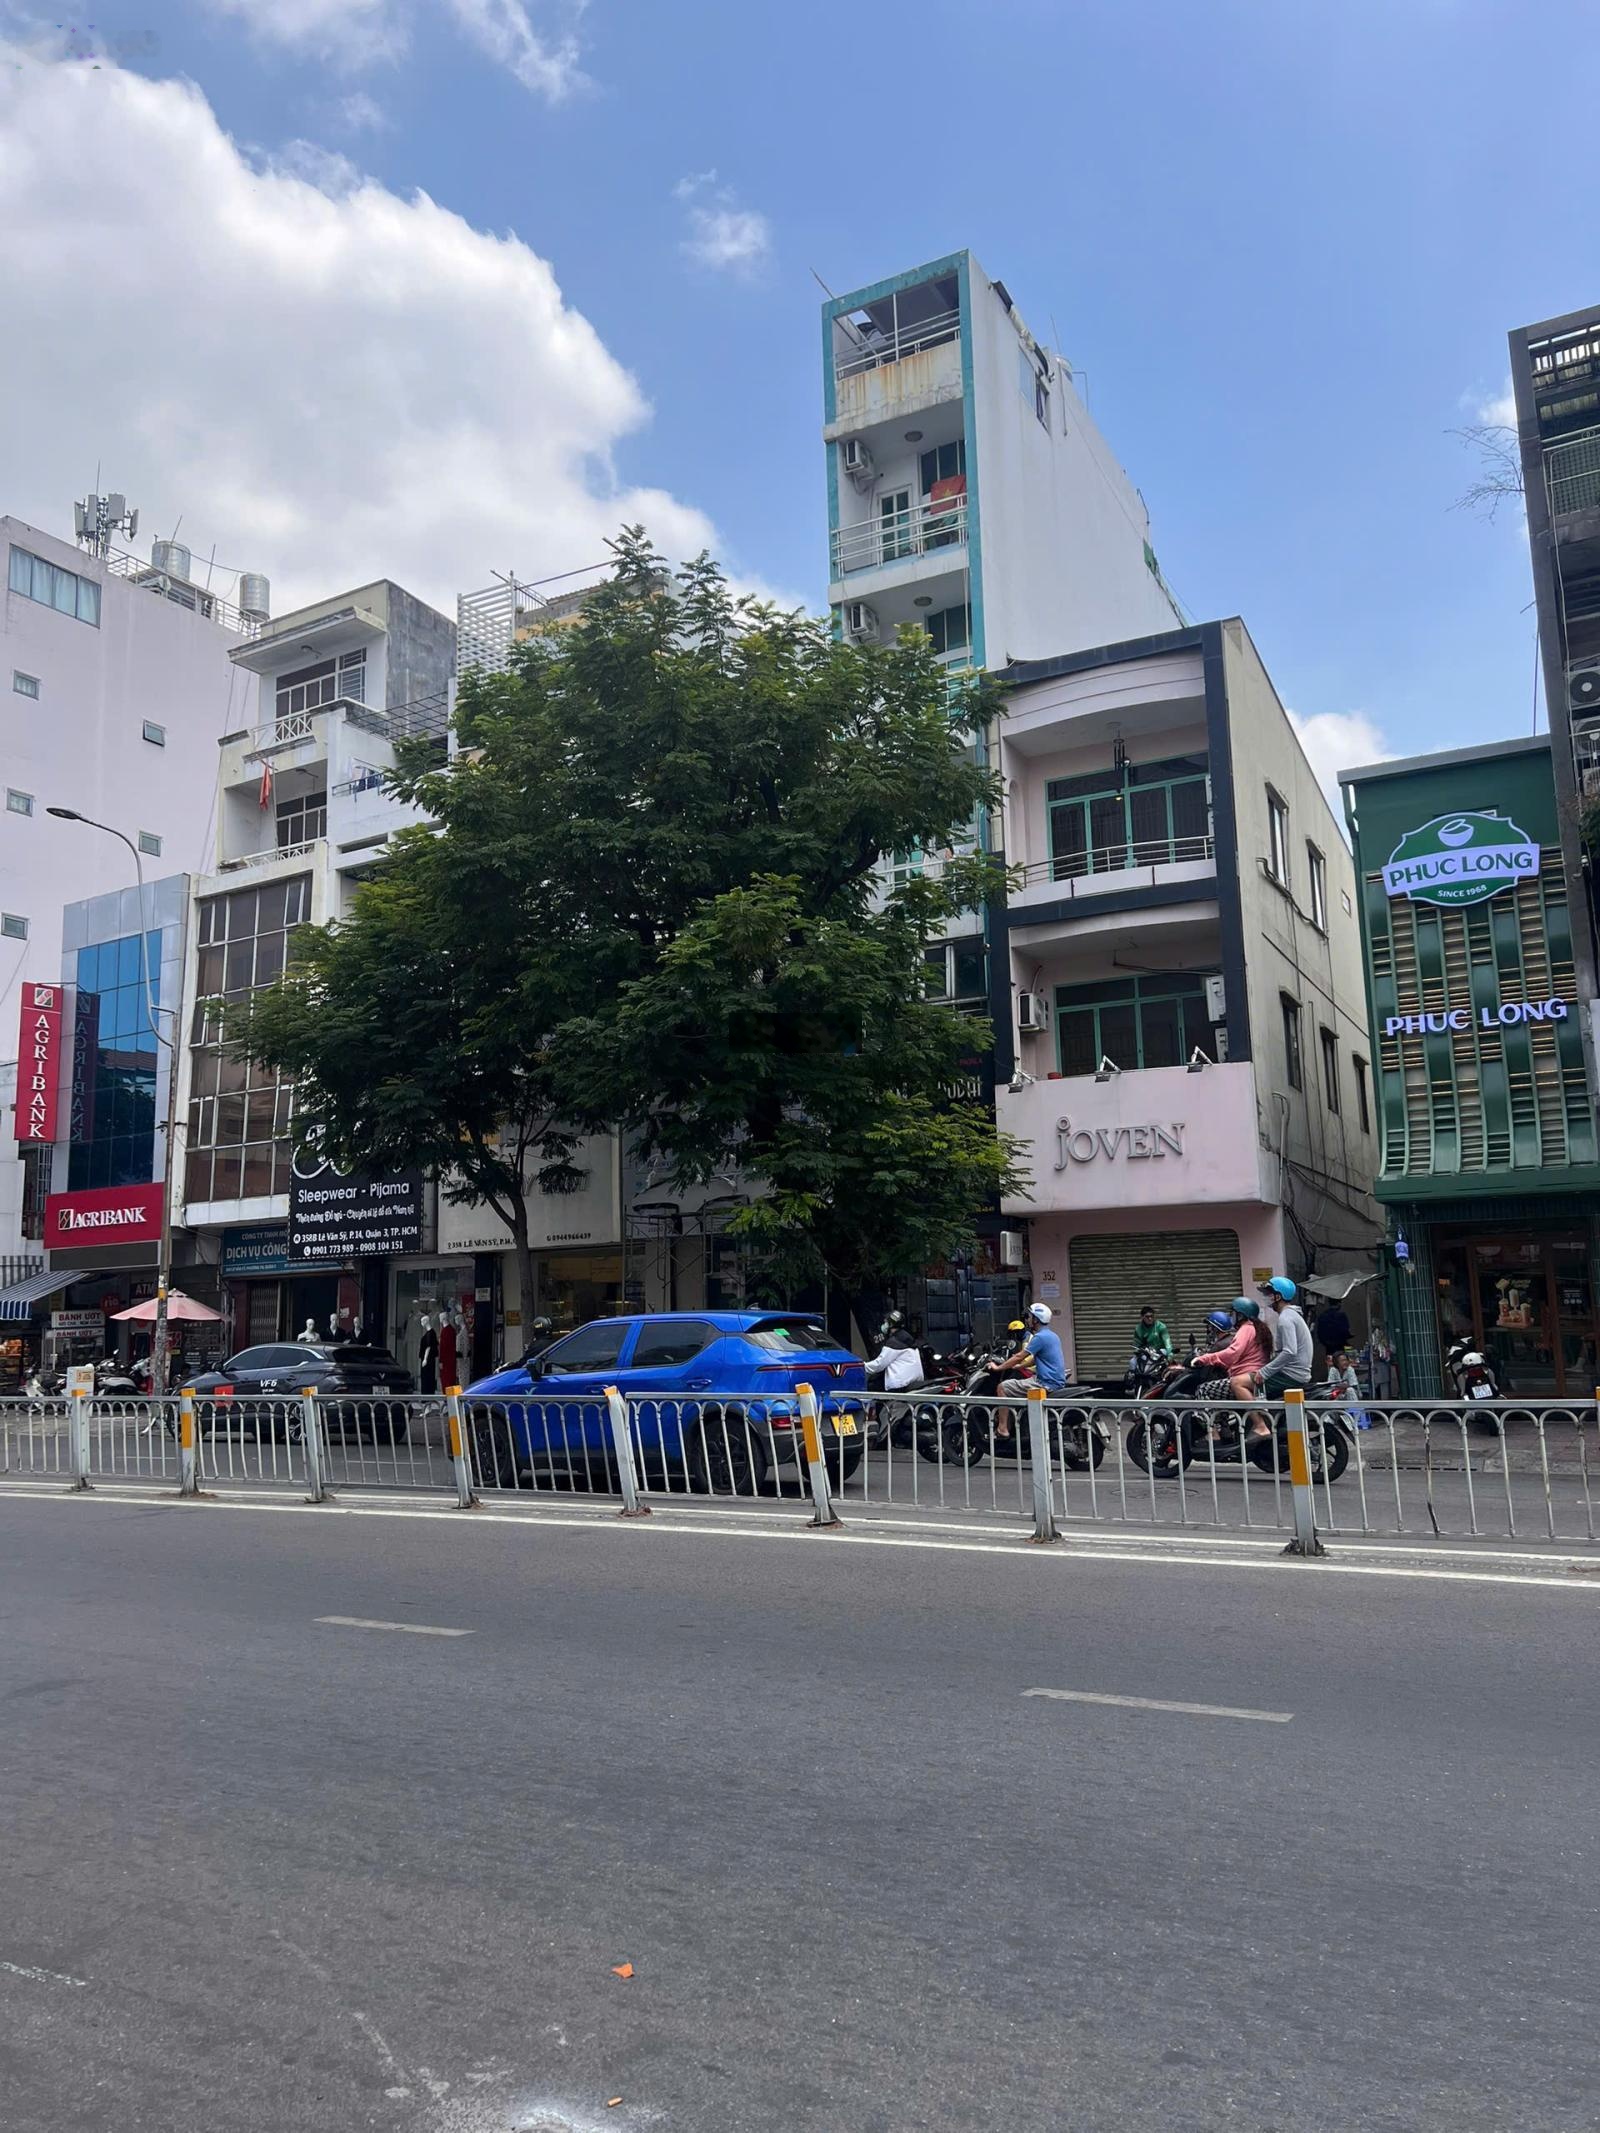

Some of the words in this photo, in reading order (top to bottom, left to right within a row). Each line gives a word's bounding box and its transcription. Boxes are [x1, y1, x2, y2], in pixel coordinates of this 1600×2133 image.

[1388, 858, 1457, 888] PHUC
[1462, 851, 1533, 873] LONG
[1437, 889, 1465, 898] SINCE
[1466, 885, 1487, 897] 1968
[1386, 1009, 1472, 1037] PHUC
[1482, 998, 1568, 1026] LONG
[29, 1014, 51, 1139] AGRIBANK
[298, 1187, 357, 1204] Sleepwear
[370, 1182, 409, 1199] Pijama
[73, 1206, 147, 1229] AGRIBANK
[402, 1226, 417, 1235] HCM
[226, 1245, 247, 1262] DỊCH
[248, 1245, 261, 1260] VỤ
[262, 1242, 287, 1257] CÔNG
[312, 1245, 327, 1255] 0901
[329, 1244, 341, 1254] 773
[378, 1241, 390, 1250] 104
[391, 1240, 403, 1249] 151
[1043, 1270, 1056, 1281] 352
